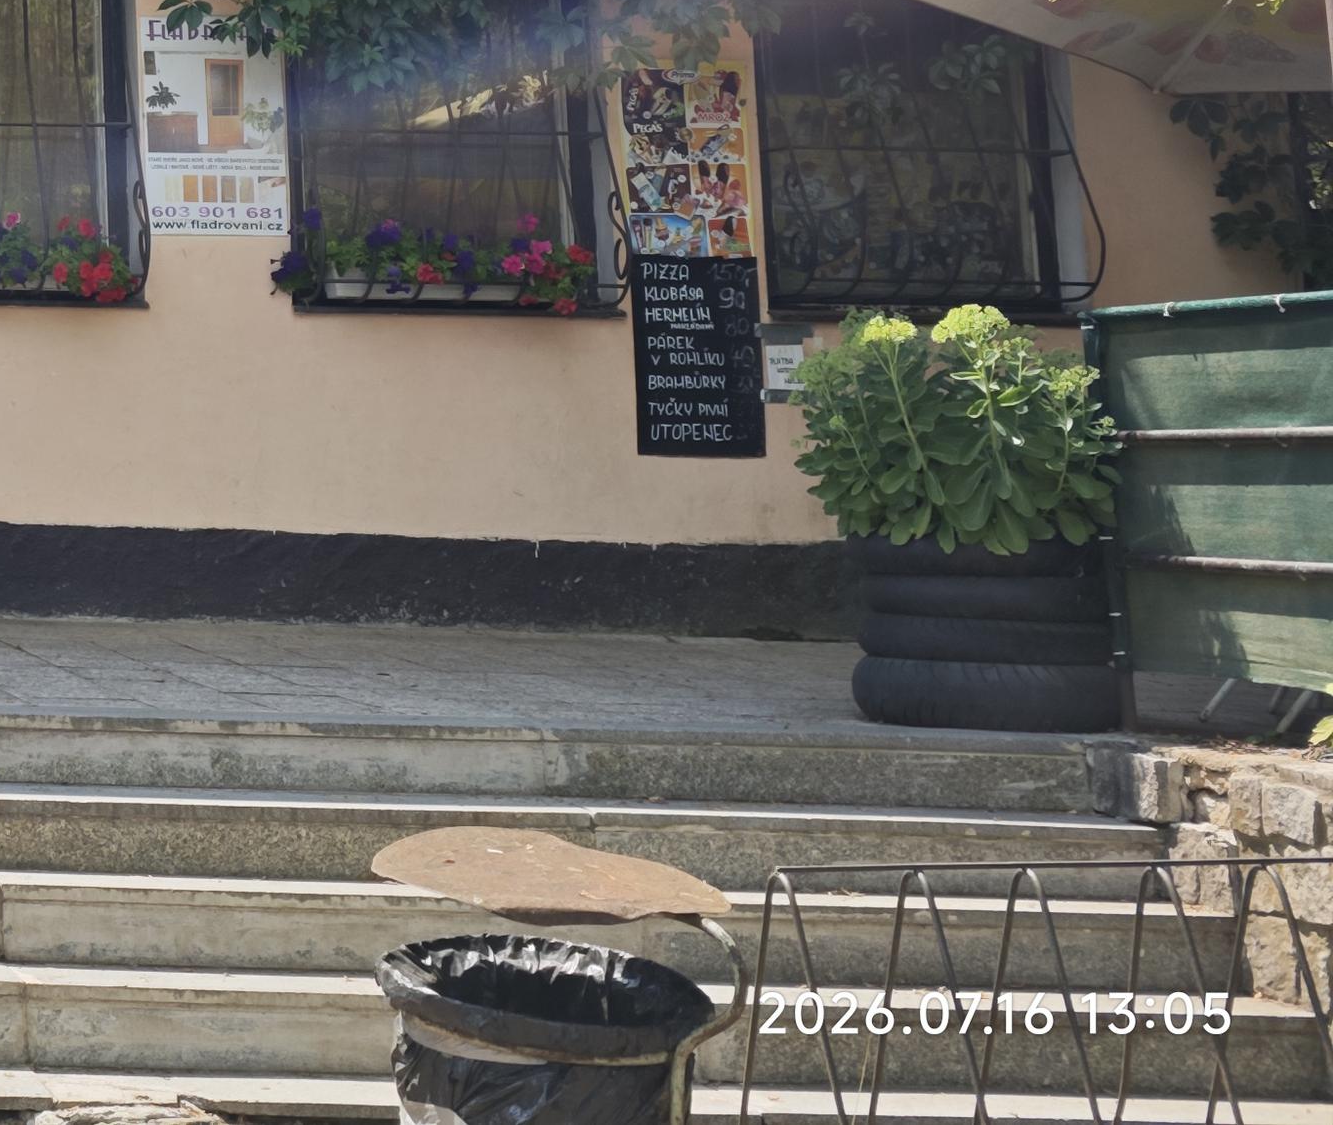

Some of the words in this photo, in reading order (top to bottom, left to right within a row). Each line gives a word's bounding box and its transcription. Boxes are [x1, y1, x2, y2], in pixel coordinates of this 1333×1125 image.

[152, 206, 191, 218] 603
[198, 206, 236, 219] 901
[246, 207, 283, 220] 681
[153, 220, 283, 231] www.fladrovani.cz
[640, 262, 690, 281] PIZZA
[644, 284, 704, 302] KLOBÁSA
[645, 303, 711, 323] HERMELÍN
[647, 332, 694, 350] PÁREK
[669, 347, 725, 366] ROHLÍKU
[648, 397, 694, 416] TYČKY
[698, 398, 729, 417] PIVNÍ
[651, 423, 733, 442] UTOPENEC
